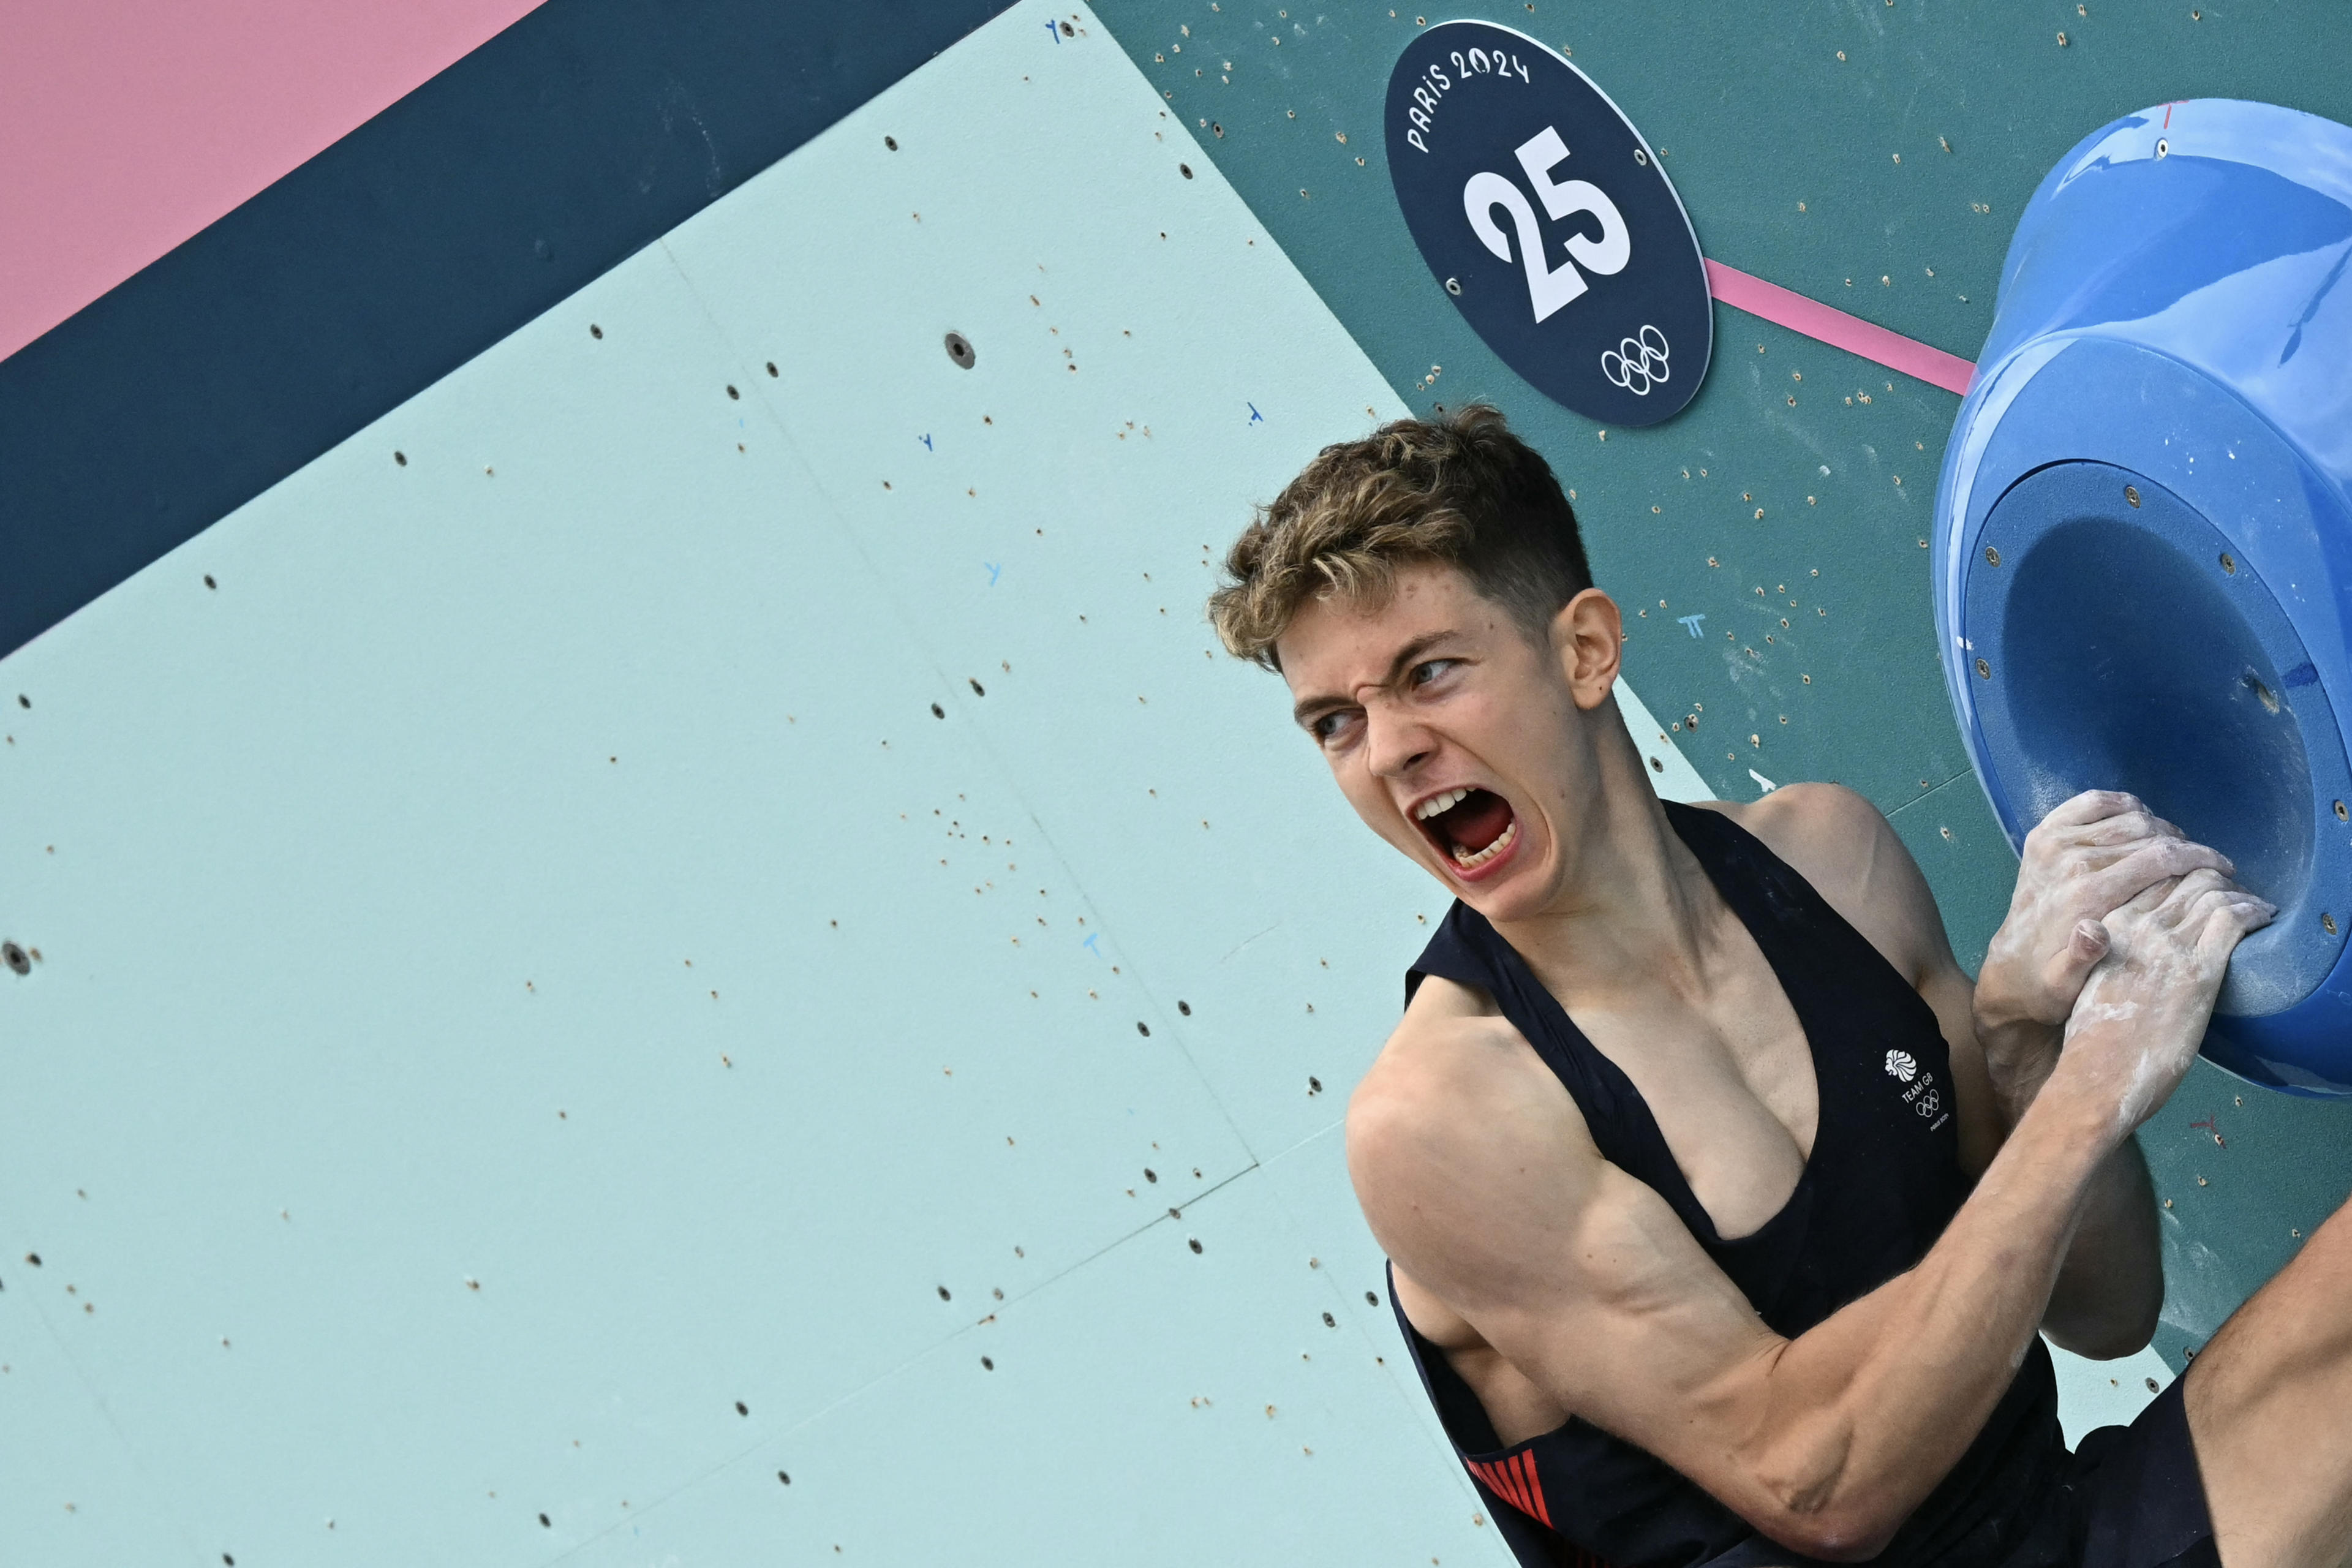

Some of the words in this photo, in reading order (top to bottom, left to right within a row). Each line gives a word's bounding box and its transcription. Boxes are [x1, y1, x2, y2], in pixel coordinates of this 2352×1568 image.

[1450, 47, 1529, 84] 2024
[1463, 126, 1630, 324] 25
[1901, 1080, 1924, 1104] TEAM
[1922, 1072, 1933, 1086] GB
